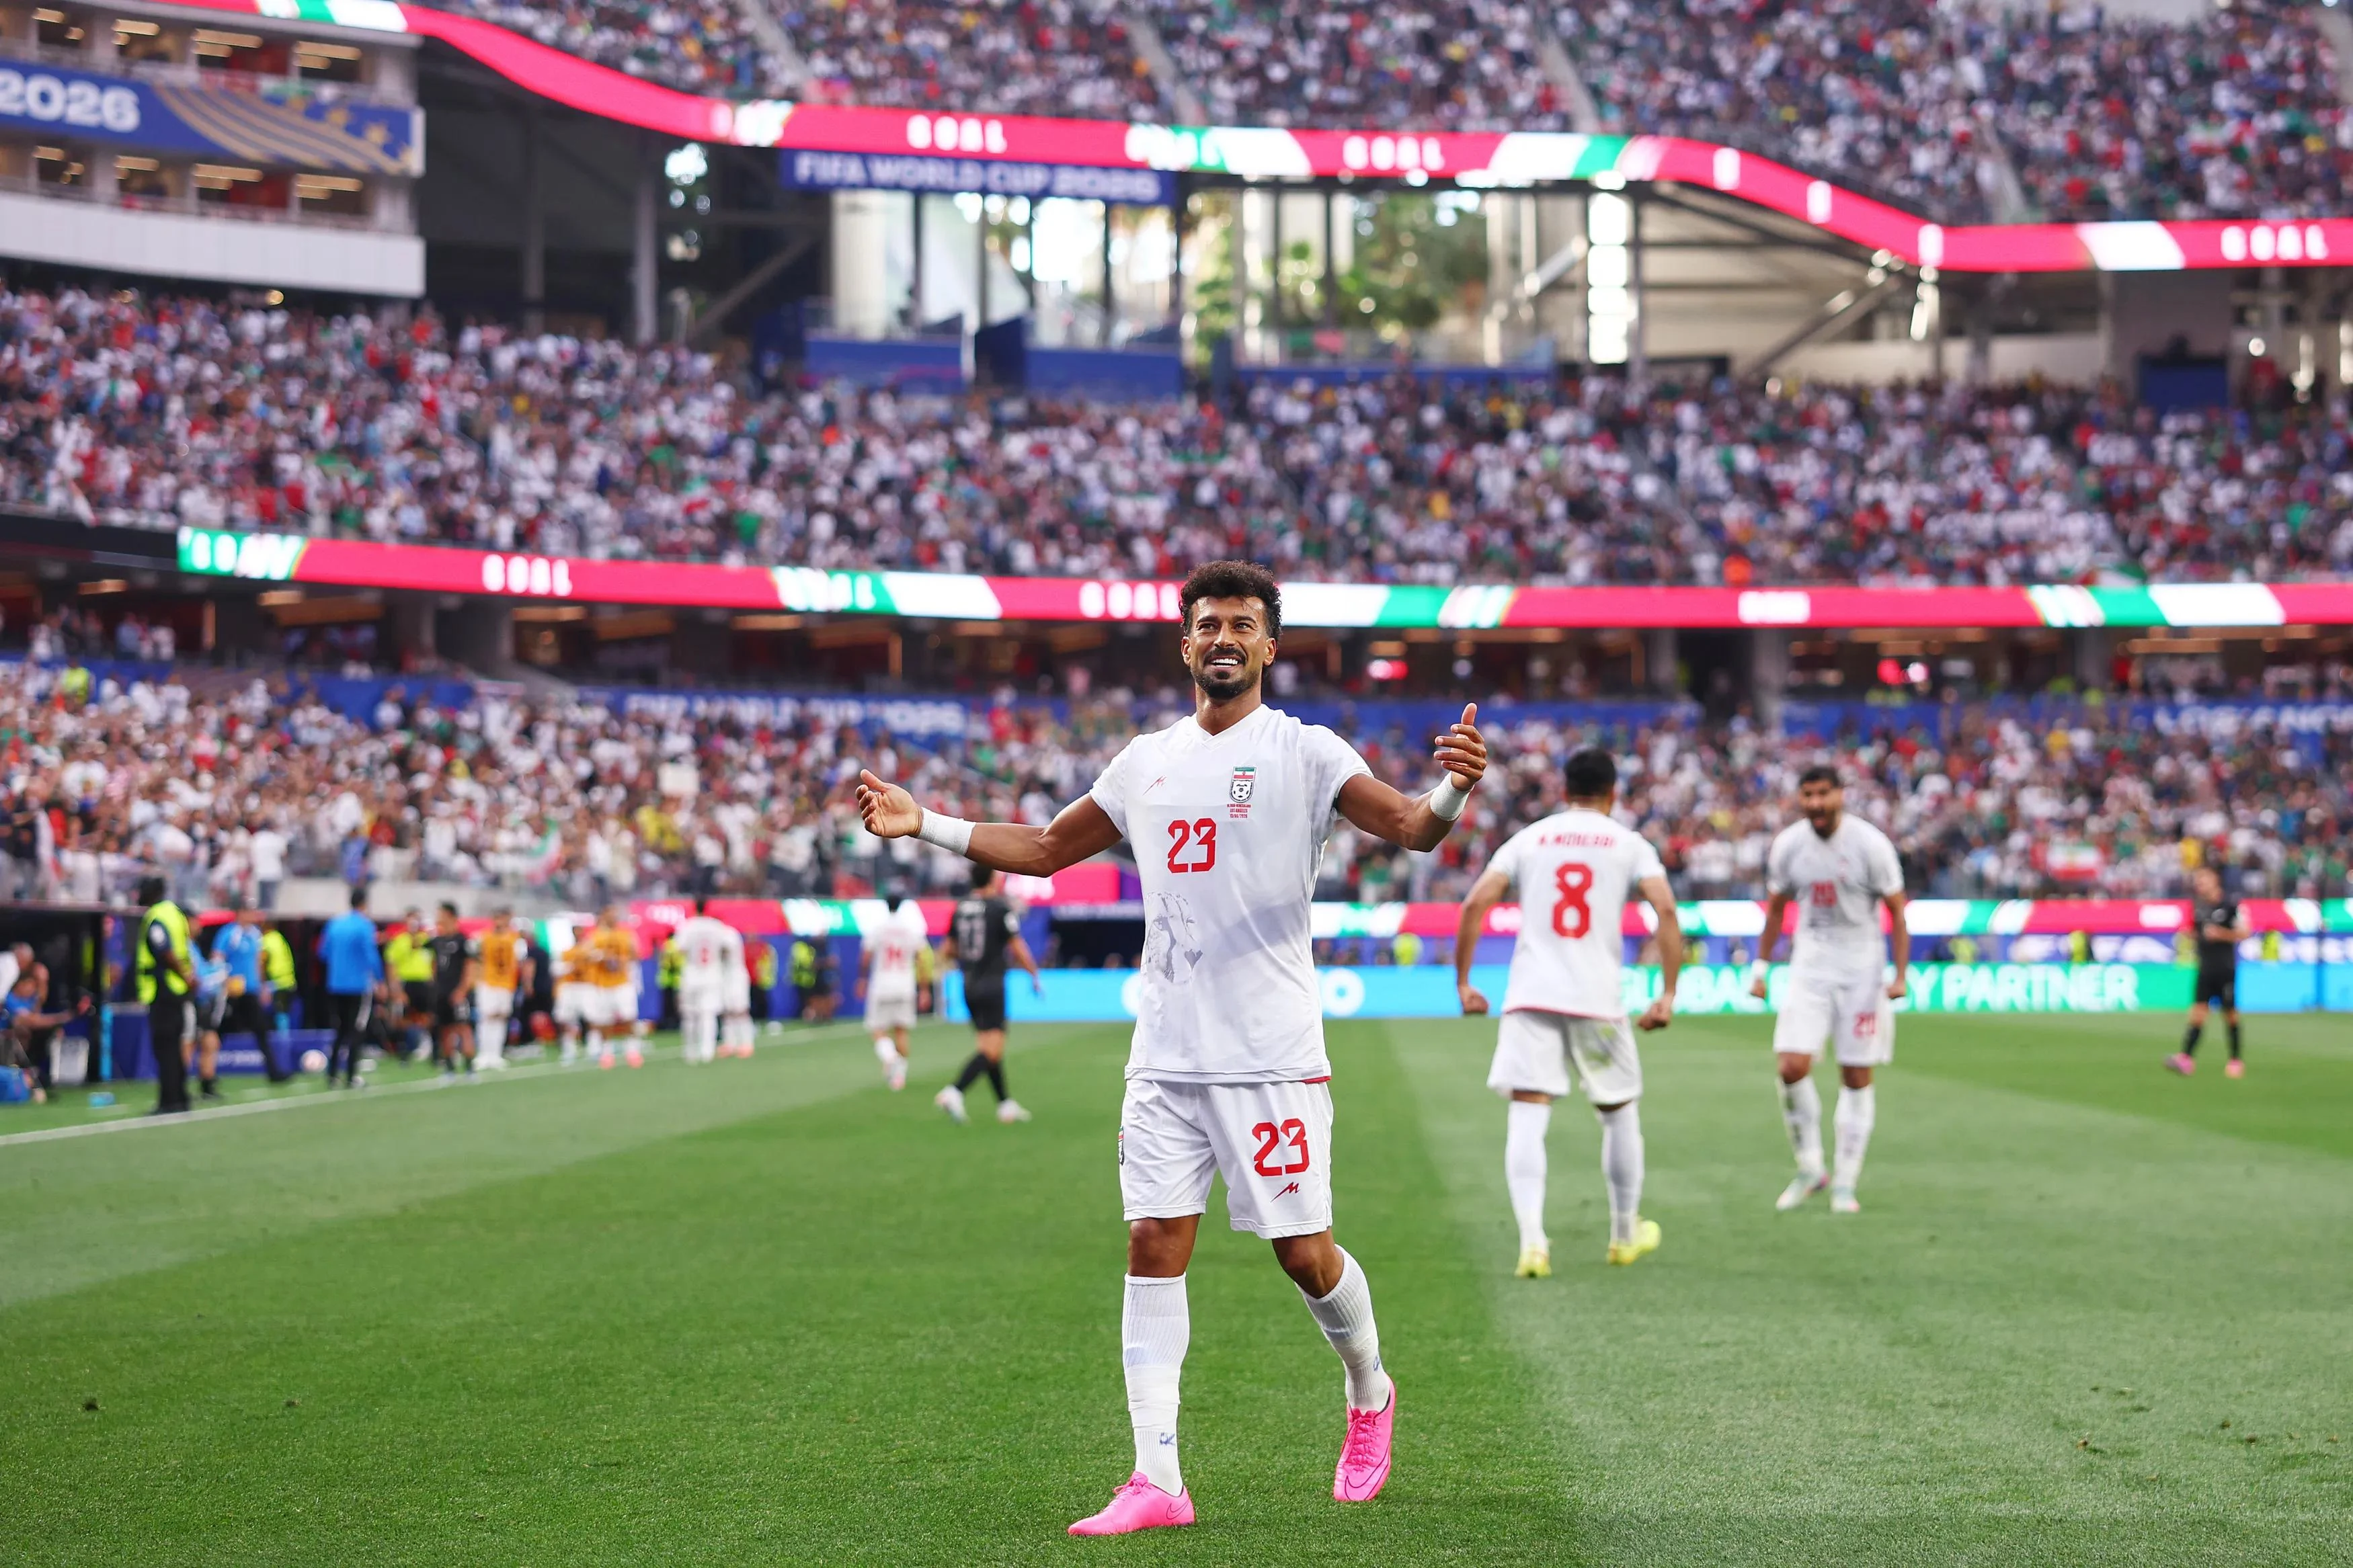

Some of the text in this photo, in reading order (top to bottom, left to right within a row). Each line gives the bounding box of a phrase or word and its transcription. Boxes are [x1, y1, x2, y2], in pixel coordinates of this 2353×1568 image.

[0, 69, 141, 132] 2026
[795, 153, 1161, 200] FIFA WORLD CUP 2026
[1168, 818, 1216, 873] 23
[1552, 863, 1593, 939] 8
[1943, 965, 2139, 1014] PARTNER
[1252, 1118, 1310, 1176] 23
